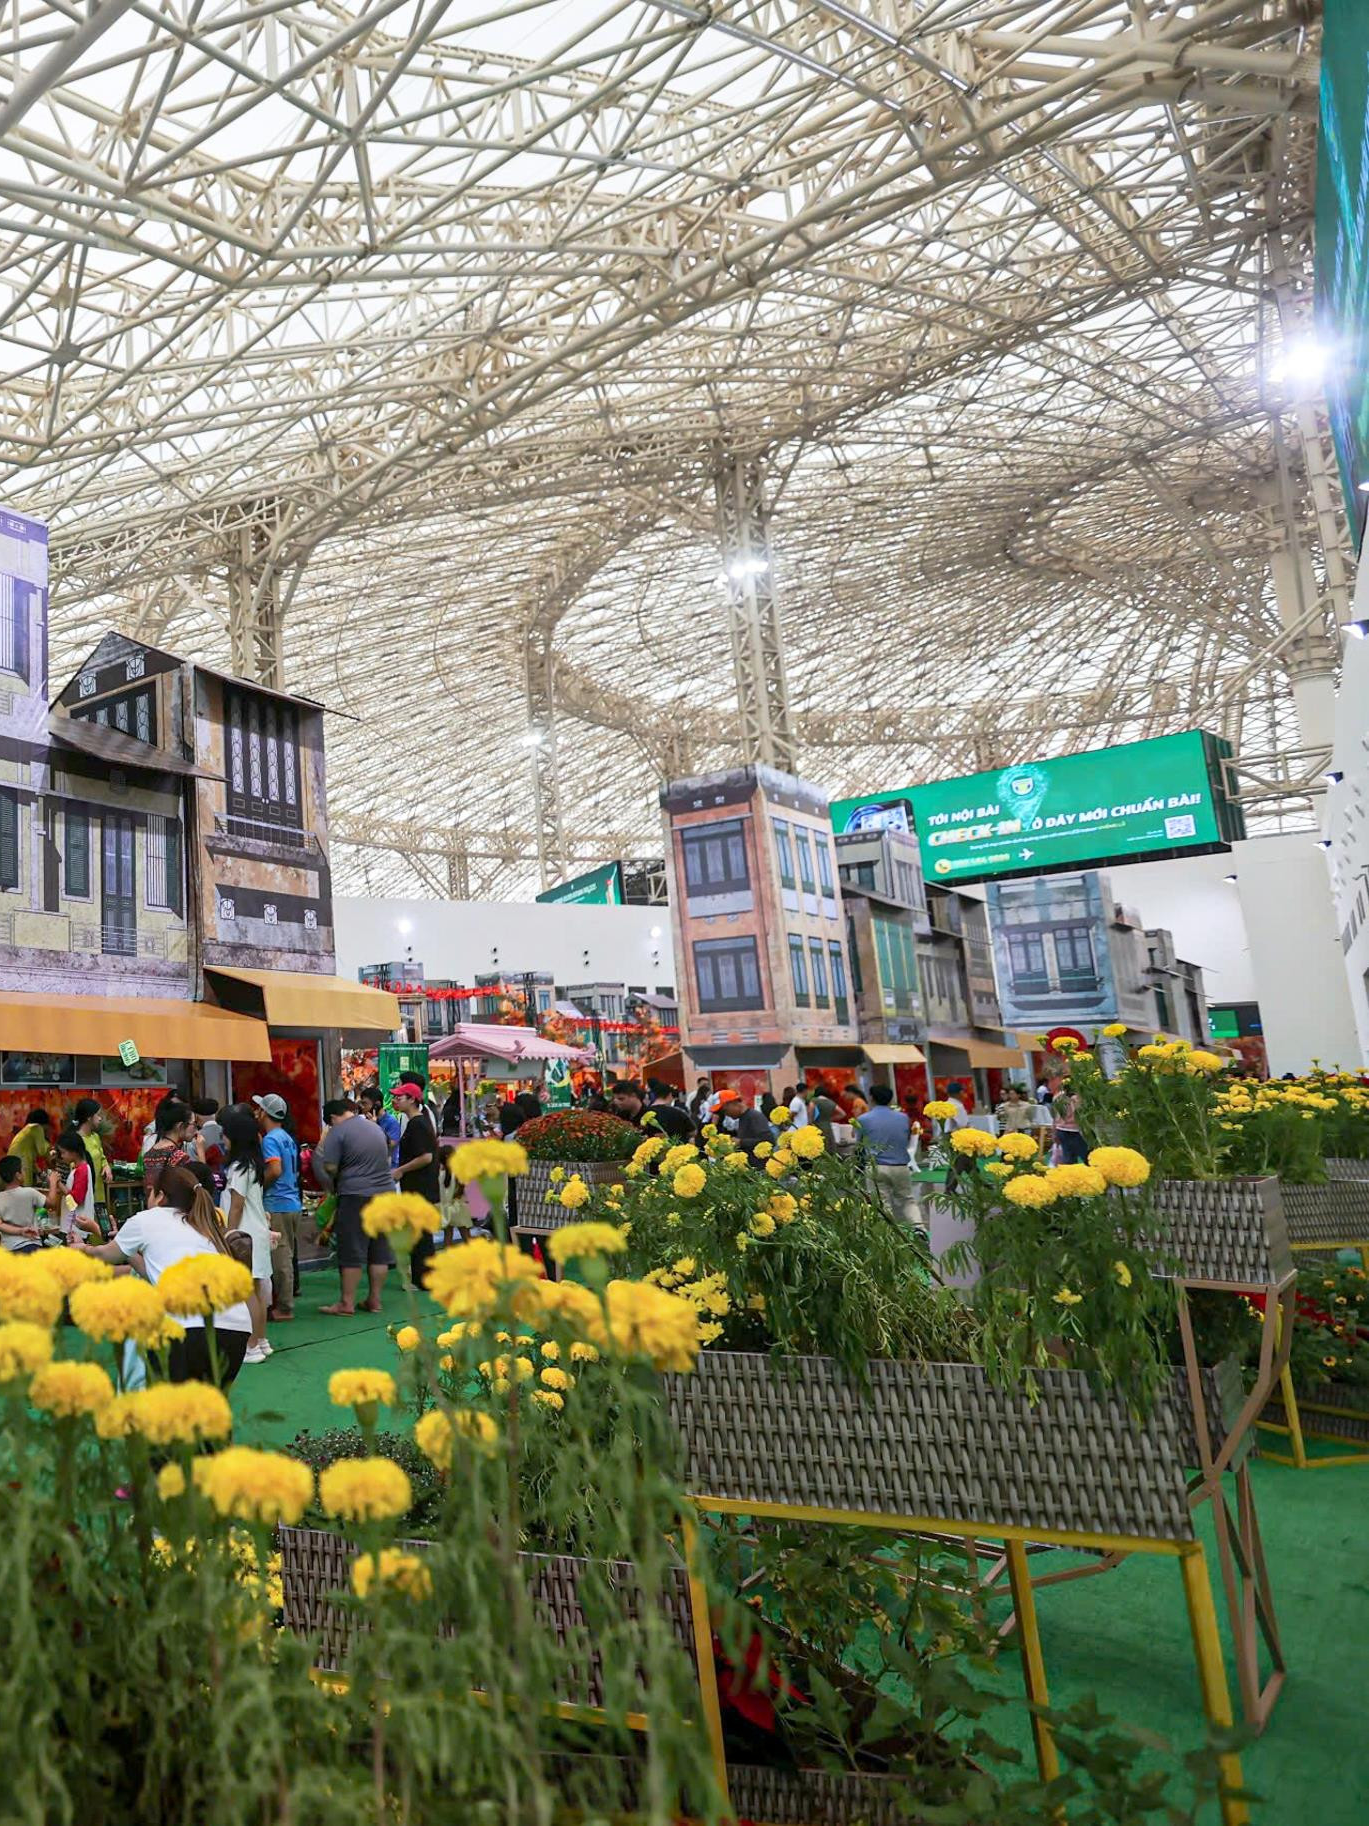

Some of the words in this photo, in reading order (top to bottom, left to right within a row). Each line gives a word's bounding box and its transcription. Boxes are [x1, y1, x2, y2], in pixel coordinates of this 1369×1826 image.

[951, 808, 975, 823] NỘI
[977, 803, 1000, 819] BÀI
[928, 818, 1022, 847] CHECK-IN
